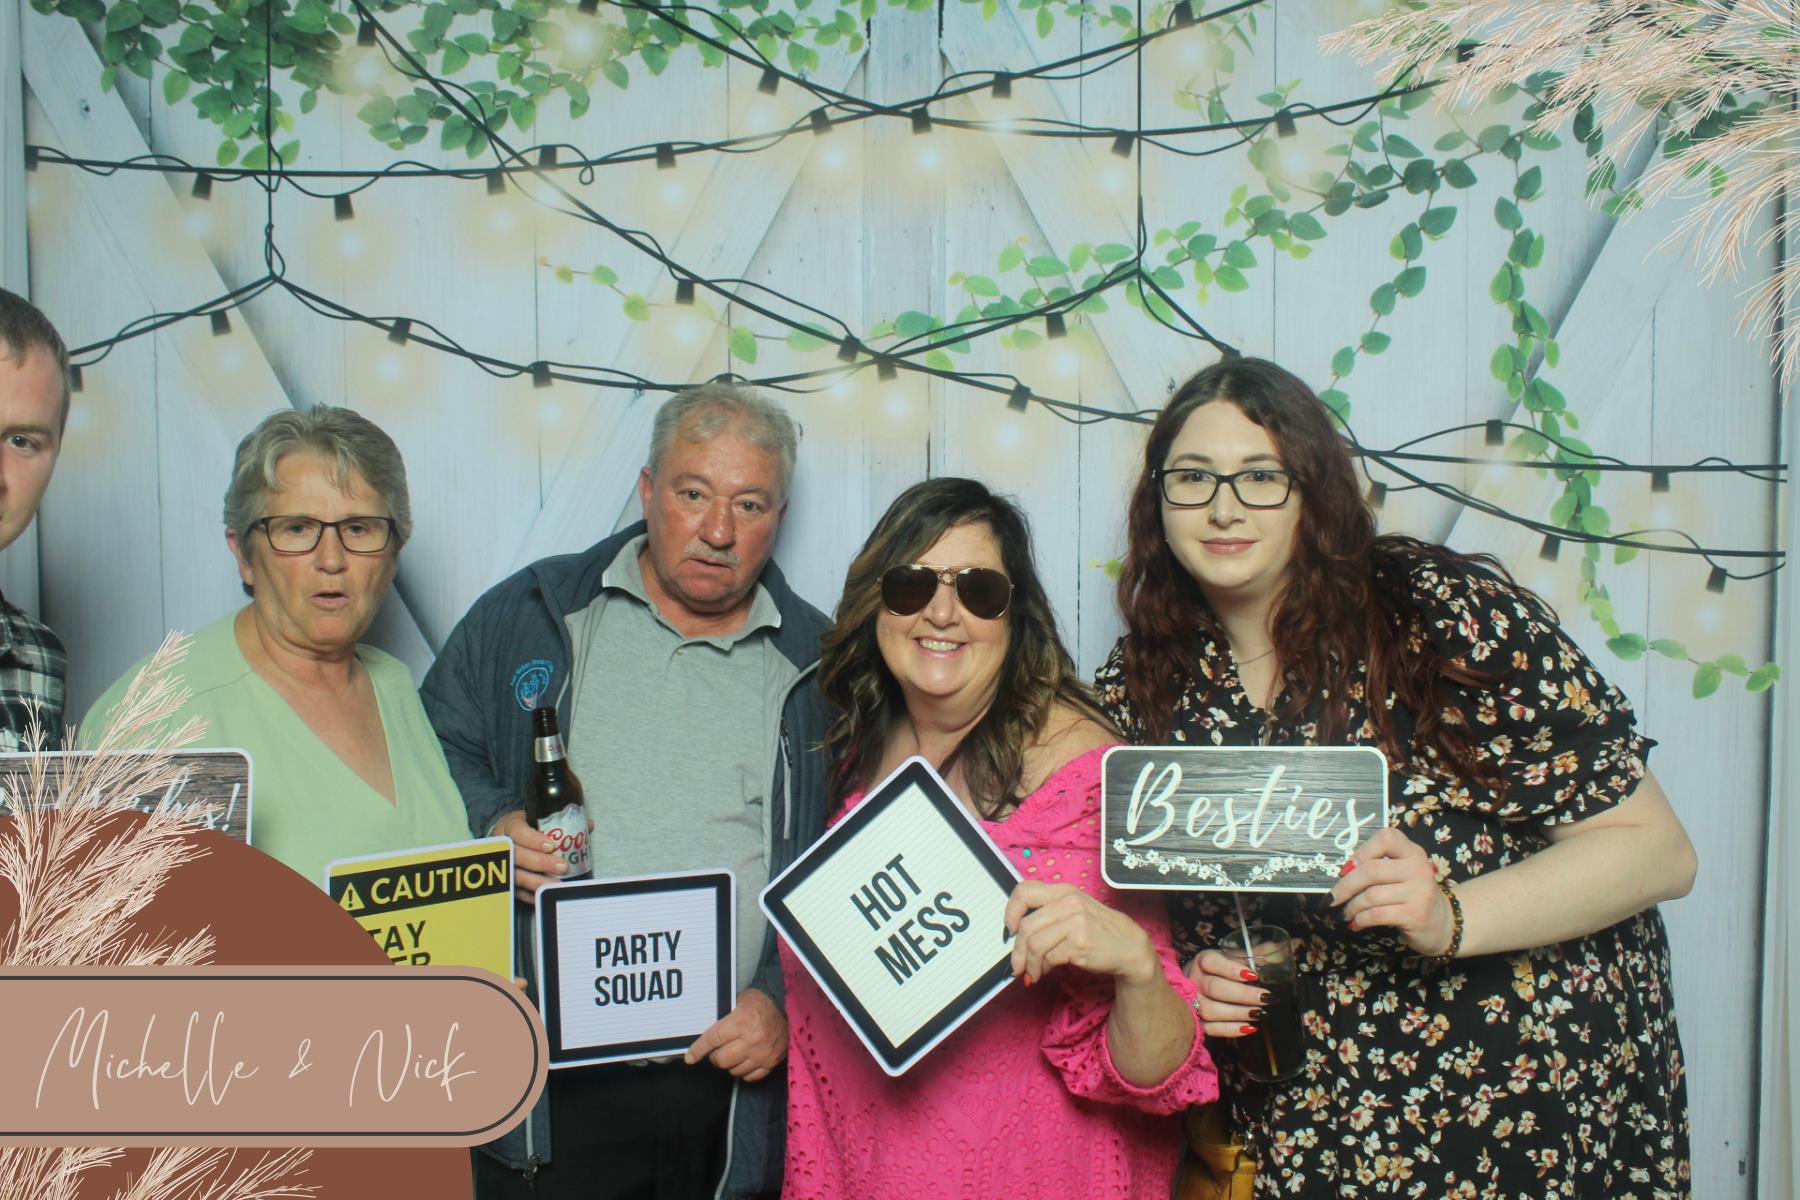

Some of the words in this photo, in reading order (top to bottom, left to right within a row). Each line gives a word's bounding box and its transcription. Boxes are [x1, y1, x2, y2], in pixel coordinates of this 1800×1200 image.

[1125, 761, 1377, 849] Besties
[370, 859, 507, 905] CAUTION
[850, 853, 923, 932] HOT
[594, 930, 683, 969] PARTY
[873, 891, 971, 986] MESS
[594, 968, 683, 1007] SQUAD
